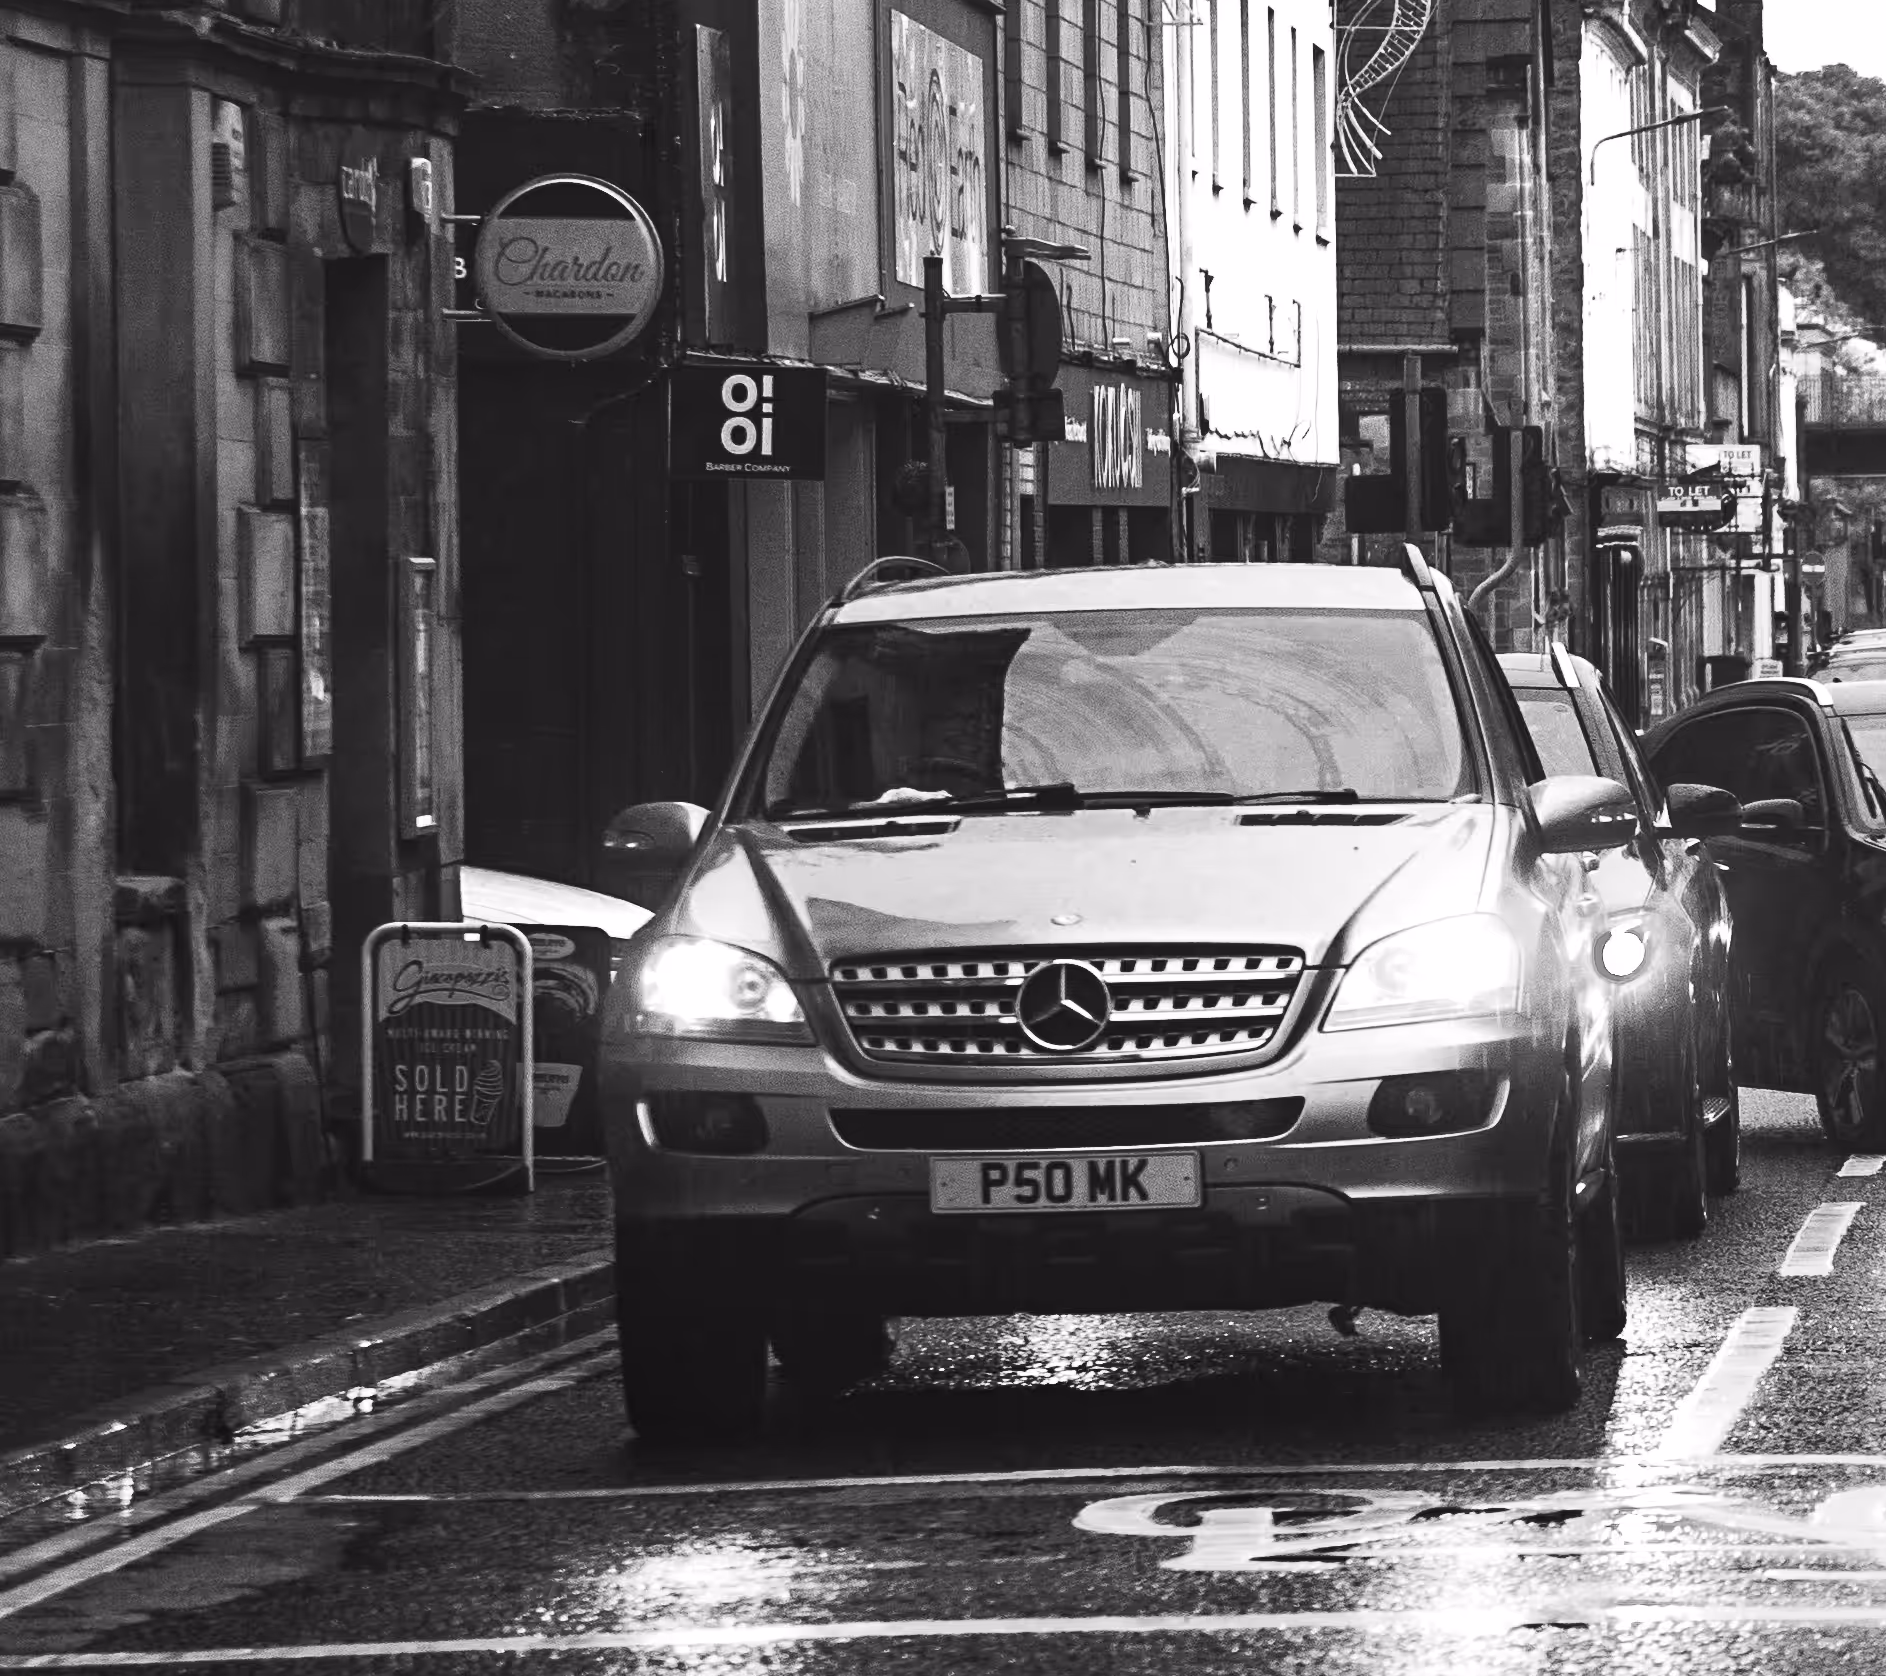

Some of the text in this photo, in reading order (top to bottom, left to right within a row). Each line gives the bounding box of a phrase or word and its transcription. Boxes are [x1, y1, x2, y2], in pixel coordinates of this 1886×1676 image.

[494, 236, 646, 287] Chardon
[1668, 486, 1711, 497] TO LET
[394, 1064, 469, 1093] SOLD
[394, 1094, 468, 1123] HERE
[1089, 1157, 1150, 1203] MK
